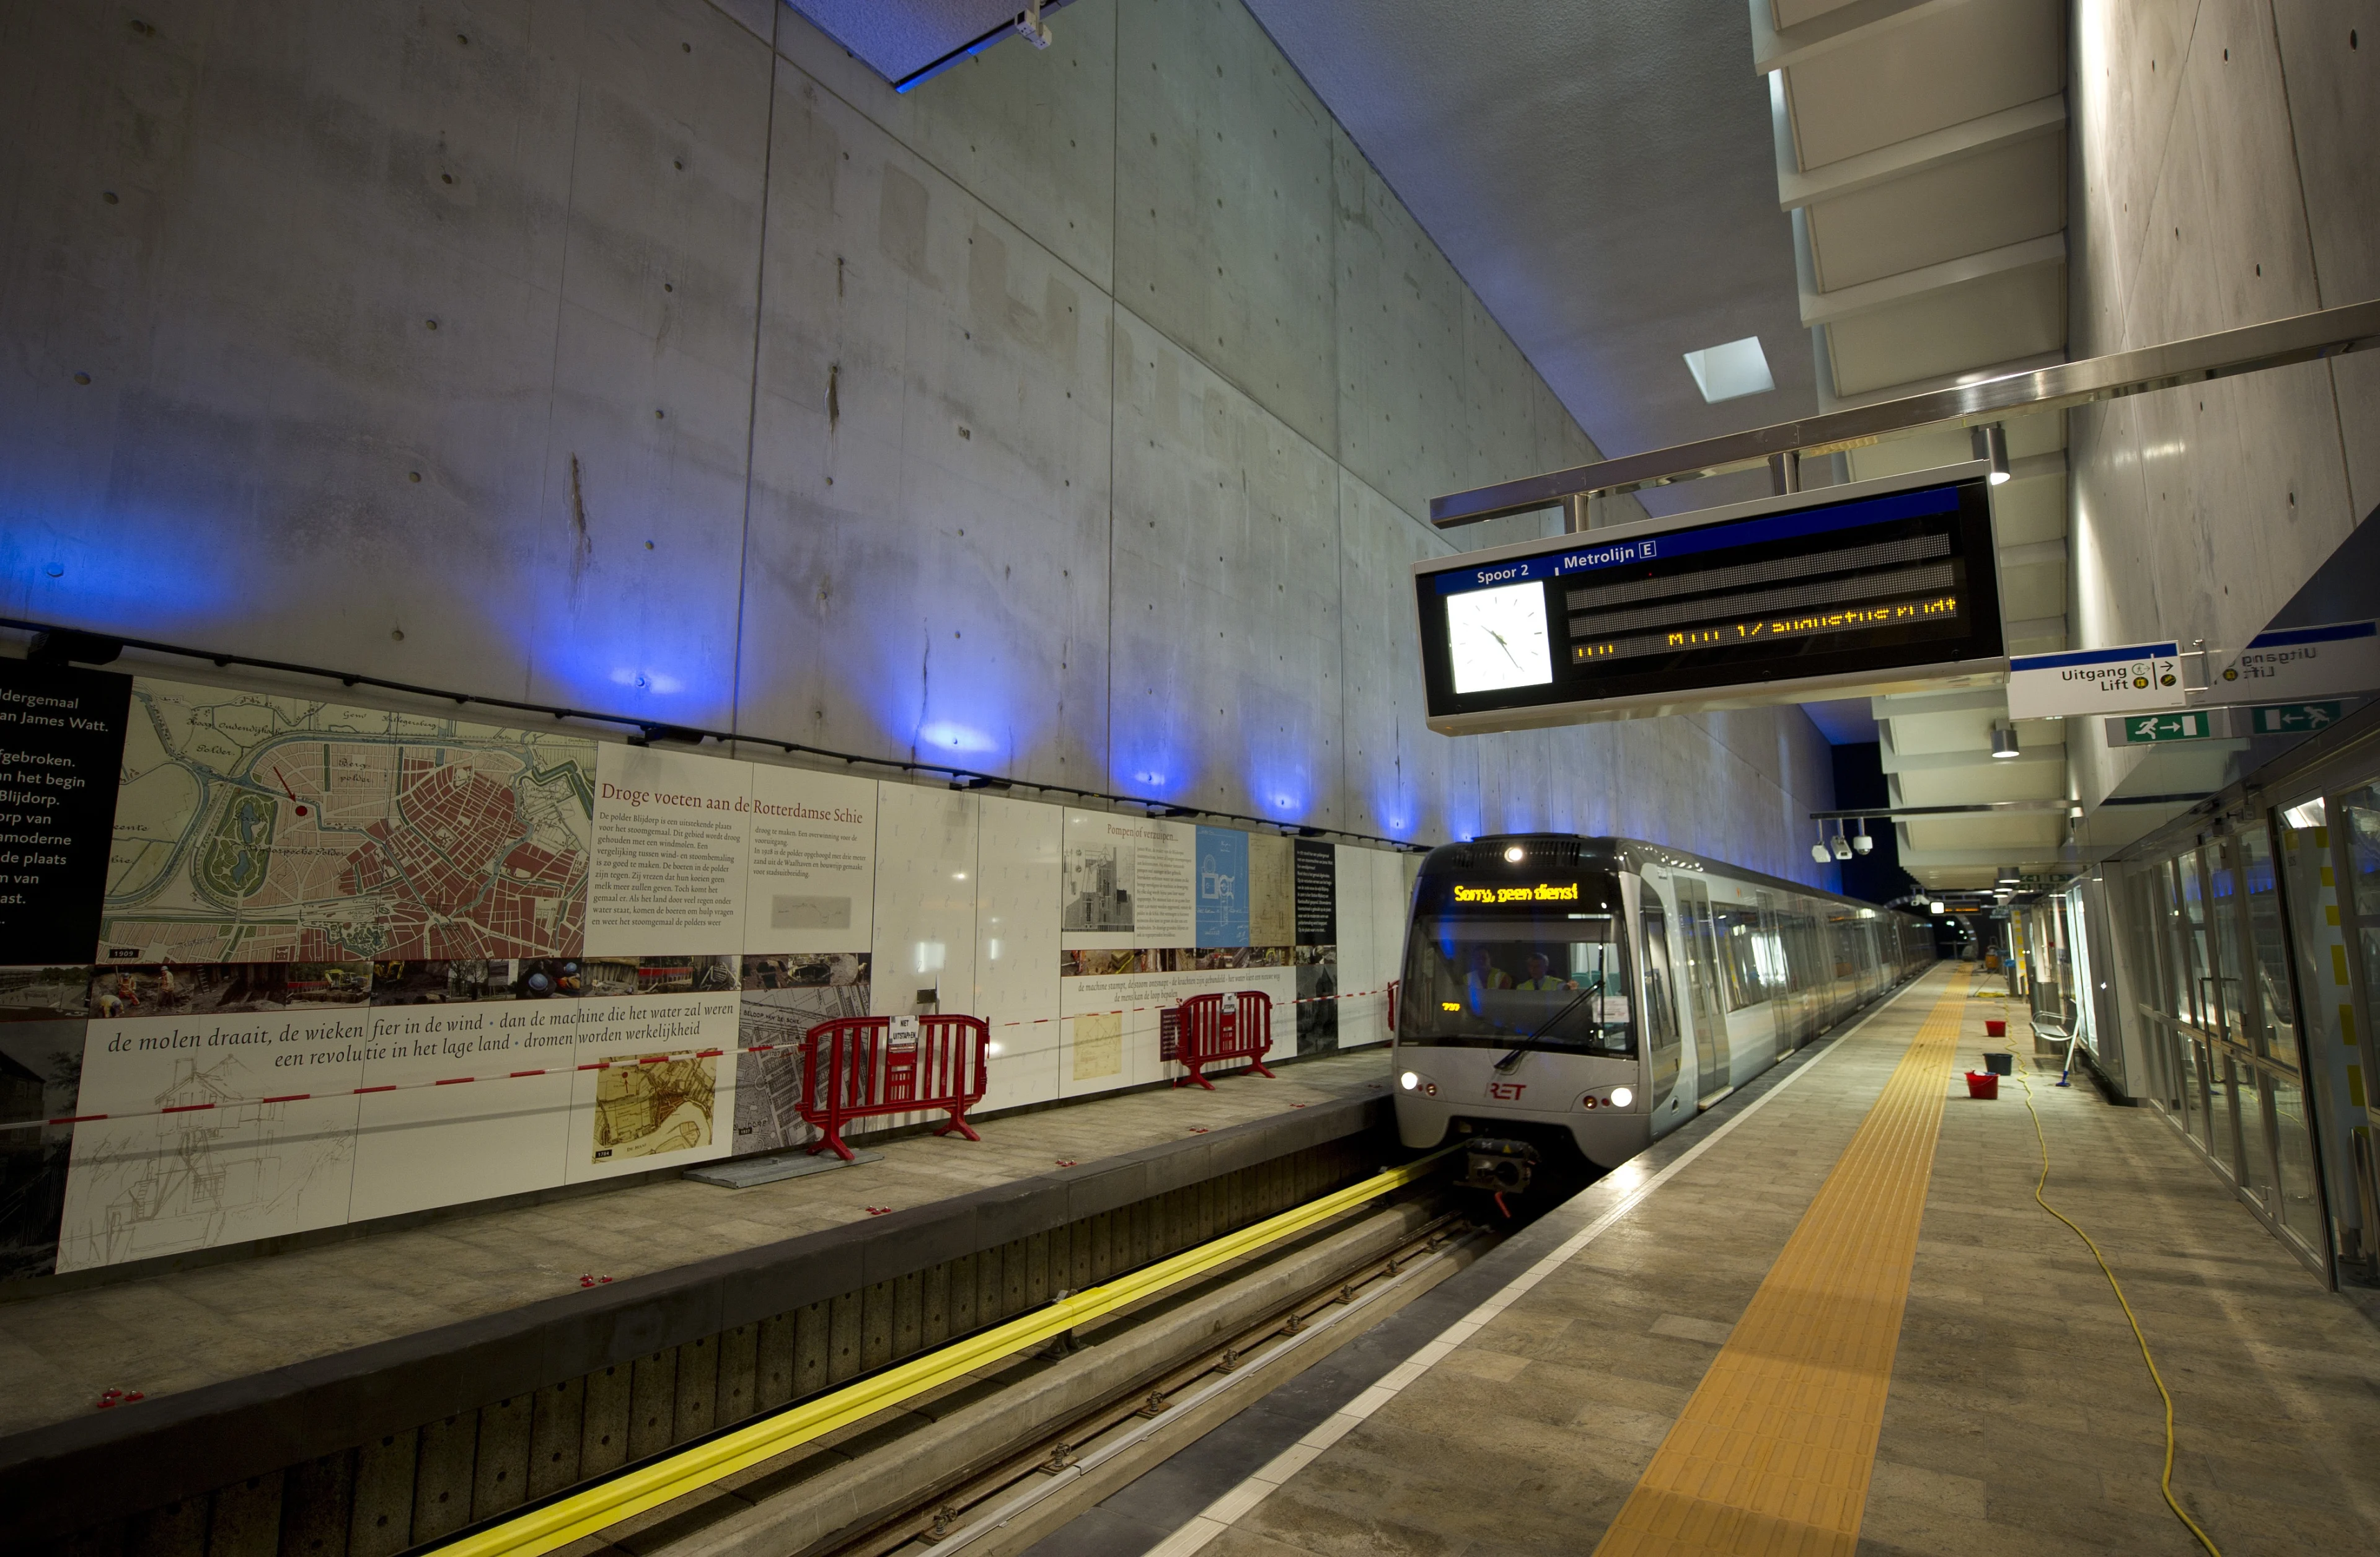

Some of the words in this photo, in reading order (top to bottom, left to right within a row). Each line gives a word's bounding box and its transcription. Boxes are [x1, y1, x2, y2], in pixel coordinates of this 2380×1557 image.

[1564, 546, 1635, 568] Metrolijn
[1477, 567, 1517, 584] Spoor
[1520, 564, 1529, 576] 2
[2061, 667, 2127, 681] Uitgang
[2100, 679, 2129, 691] Lift
[19, 712, 64, 726] James
[69, 717, 108, 731] Watt.
[17, 771, 42, 783] het
[45, 773, 85, 790] begin
[0, 790, 60, 808] Blijdorp.
[601, 783, 650, 806] Droge
[654, 793, 702, 808] voeten
[706, 799, 730, 810] aan
[734, 796, 750, 813] de
[753, 800, 831, 820] Rotterdamse
[833, 808, 863, 823] Schie
[26, 815, 51, 824] van
[599, 811, 609, 819] De
[610, 813, 632, 823] polder
[633, 814, 659, 826] Blijdorp
[660, 816, 666, 824] is
[679, 819, 714, 828] uitstekende
[715, 822, 732, 831] plaats
[615, 824, 626, 832] het
[627, 827, 671, 836] stoomgemaal.
[672, 829, 683, 837] Dit
[684, 830, 704, 839] gebied
[723, 832, 741, 843] droog
[754, 826, 771, 836] droog
[778, 828, 797, 836] maken.
[808, 832, 839, 842] overwinning
[1107, 823, 1134, 839] Pompen
[1135, 826, 1144, 837] of
[597, 835, 631, 845] gehouden
[659, 839, 695, 849] windmolen.
[754, 838, 788, 847] vooruitgang.
[0, 851, 19, 863] de
[23, 852, 66, 867] plaats
[596, 847, 637, 858] vergelijking
[660, 850, 679, 858] wind-
[689, 853, 734, 863] stoombemaling
[596, 858, 602, 866] is
[612, 859, 628, 869] goed
[637, 860, 661, 868] maken.
[662, 862, 672, 870] De
[672, 862, 694, 870] boeren
[694, 863, 701, 871] in
[702, 863, 710, 871] de
[710, 864, 729, 874] polder
[765, 868, 809, 879] stadsuitbreiding.
[13, 875, 39, 884] van
[594, 870, 609, 880] zijn
[610, 872, 630, 881] tegen.
[631, 871, 641, 881] Zij
[664, 872, 675, 881] dat
[676, 873, 689, 881] hun
[690, 873, 710, 882] koeien
[1454, 885, 1496, 902] Sorry,
[1497, 888, 1533, 902] geen
[1534, 883, 1578, 900] dienst
[1078, 982, 1085, 992] de
[1085, 981, 1108, 991] machine
[1108, 982, 1127, 992] stampt,
[1127, 979, 1134, 989] de
[1148, 980, 1169, 989] ontsnapt
[1171, 977, 1177, 986] de
[1178, 974, 1196, 986] krachten
[1196, 975, 1205, 987] zijn
[1205, 974, 1225, 986] gebundeld
[1114, 992, 1120, 1002] de
[1134, 992, 1144, 1000] kan
[1144, 989, 1150, 1000] de
[1150, 990, 1160, 1002] loop
[1160, 989, 1178, 1001] bepalen
[108, 1033, 131, 1052] de
[139, 1030, 200, 1050] molen
[208, 1026, 272, 1046] draait,
[279, 1023, 299, 1041] de
[305, 1020, 364, 1040] wieken
[368, 1019, 400, 1042] fier
[405, 1018, 420, 1034] in
[425, 1016, 442, 1033] de
[444, 1013, 483, 1031] wind
[499, 1012, 526, 1029] dan
[529, 1010, 545, 1026] de
[549, 1008, 604, 1025] machine
[606, 1007, 625, 1021] die
[628, 1005, 647, 1020] het
[648, 1008, 682, 1019] water
[684, 1002, 701, 1018] zal
[703, 1005, 733, 1015] weren
[900, 1019, 909, 1027] NIET
[275, 1054, 304, 1067] een
[309, 1043, 387, 1064] revolutie
[392, 1041, 407, 1058] in
[412, 1039, 438, 1056] het
[442, 1038, 474, 1058] lage
[478, 1033, 510, 1051] land
[523, 1031, 574, 1048] dromen
[578, 1027, 622, 1044] worden
[625, 1021, 700, 1041] werkelijkheid
[1489, 1082, 1527, 1100] RET
